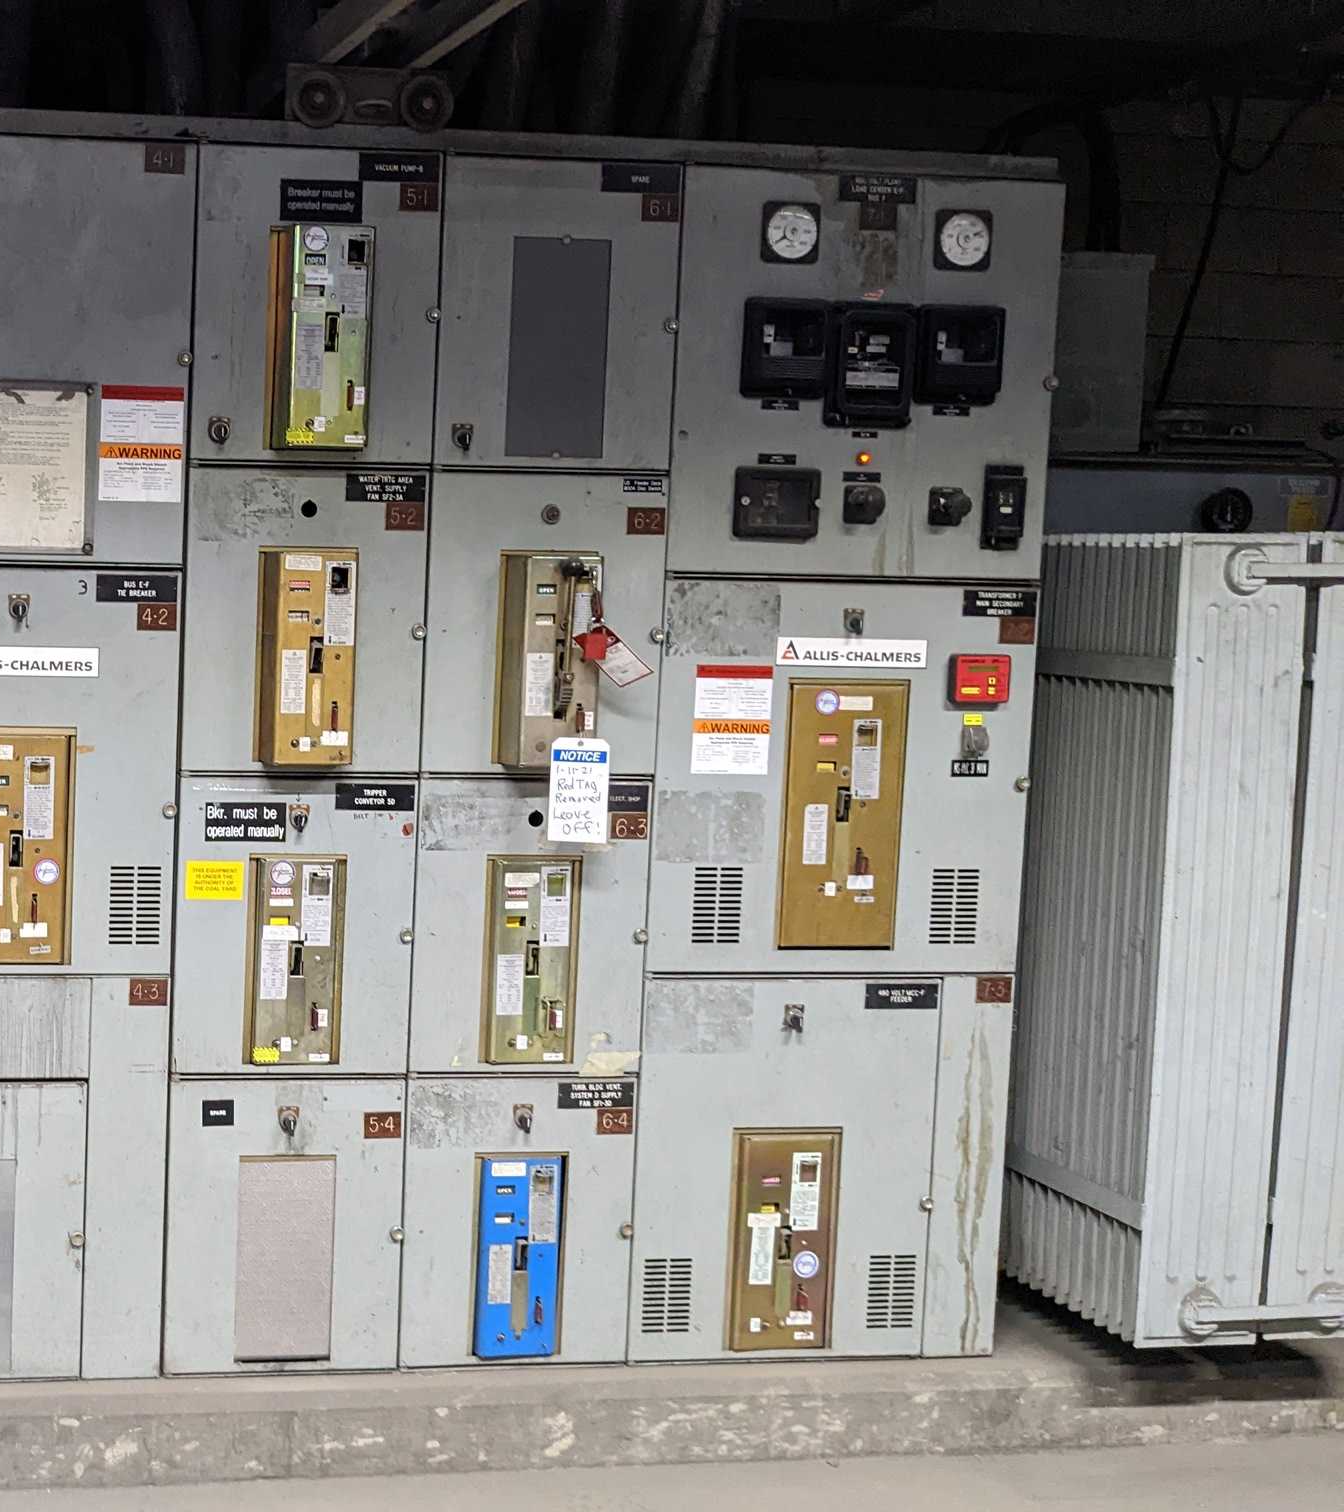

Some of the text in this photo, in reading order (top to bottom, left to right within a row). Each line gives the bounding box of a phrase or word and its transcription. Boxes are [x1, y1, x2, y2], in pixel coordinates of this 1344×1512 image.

[374, 163, 399, 172] VACUUM
[287, 186, 356, 199] Breaker must be
[287, 200, 356, 213] operated manually
[118, 447, 182, 460] WARNING
[358, 475, 378, 483] WATER
[397, 476, 414, 484] AREA
[385, 485, 407, 493] SUPPLY
[367, 493, 380, 501] FAN
[78, 579, 88, 596] 3
[123, 580, 136, 588] BUS
[117, 589, 157, 598] TIE BREAKER
[977, 591, 1016, 600] TRANSFORMER
[975, 599, 1024, 608] MAIN SECONDARY
[986, 608, 1012, 616] BREAKER
[802, 650, 921, 663] ALLIS-CHALMERS
[710, 722, 770, 734] WARNING
[559, 750, 601, 762] NOTICE
[557, 776, 575, 791] Red
[363, 789, 388, 797] TRIPPER
[554, 791, 602, 804] Removed
[354, 797, 386, 806] CONVEYOR
[206, 805, 278, 820] Bkr. must be
[206, 825, 285, 840] operated manually
[570, 1091, 593, 1099] SYSTEM
[601, 1091, 623, 1099] SUPPLY
[578, 1099, 591, 1107] FAN
